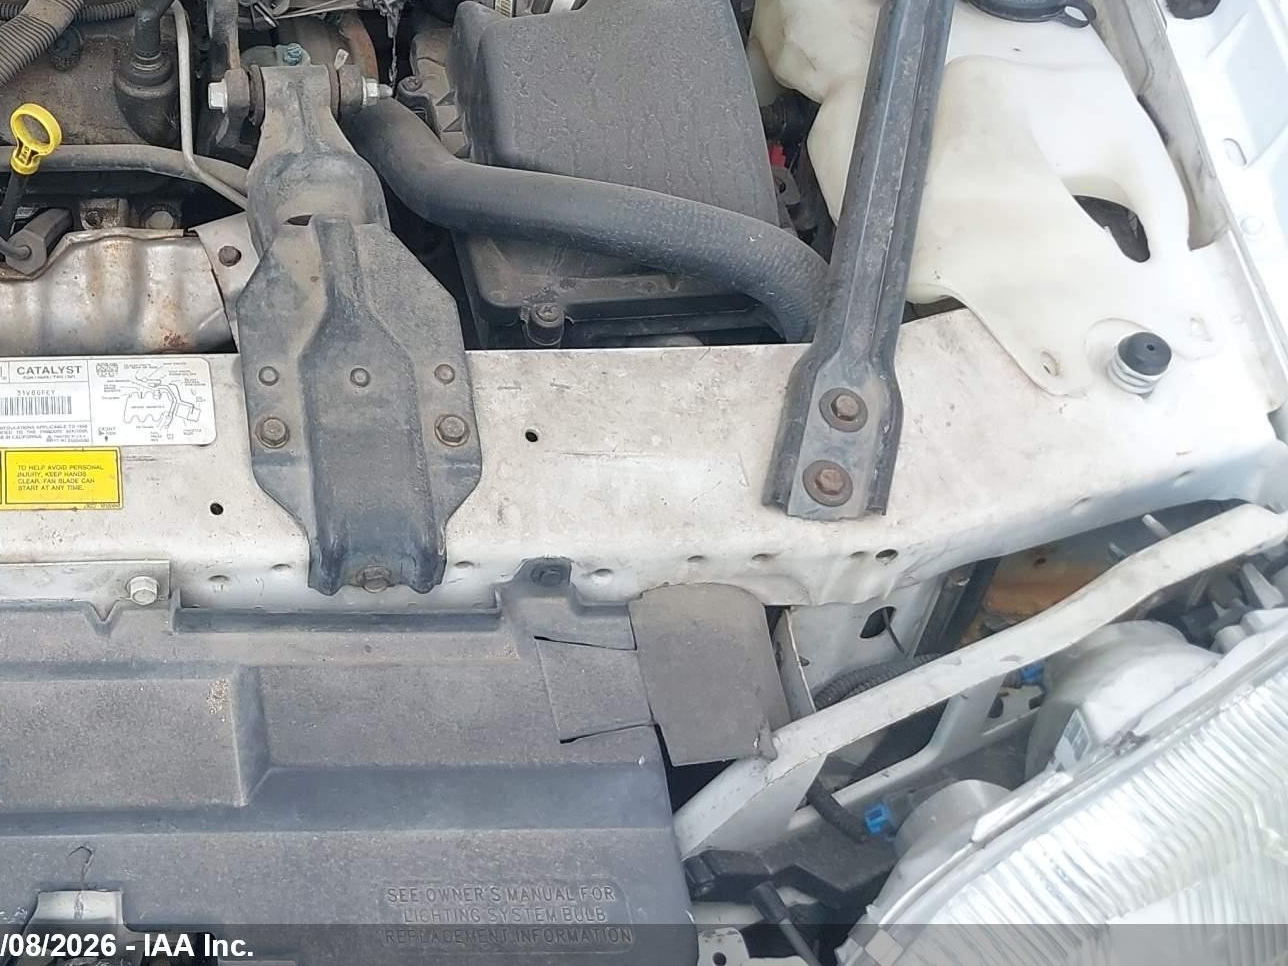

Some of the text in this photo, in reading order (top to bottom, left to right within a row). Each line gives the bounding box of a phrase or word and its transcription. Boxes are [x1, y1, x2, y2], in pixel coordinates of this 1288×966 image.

[16, 365, 83, 376] CATALYST
[387, 885, 616, 903] SEE OWNER'S MANUAL FOR
[403, 906, 607, 923] LIGHTING SYSTEM BULB
[384, 927, 633, 944] REPLACEMENT INFORMATION
